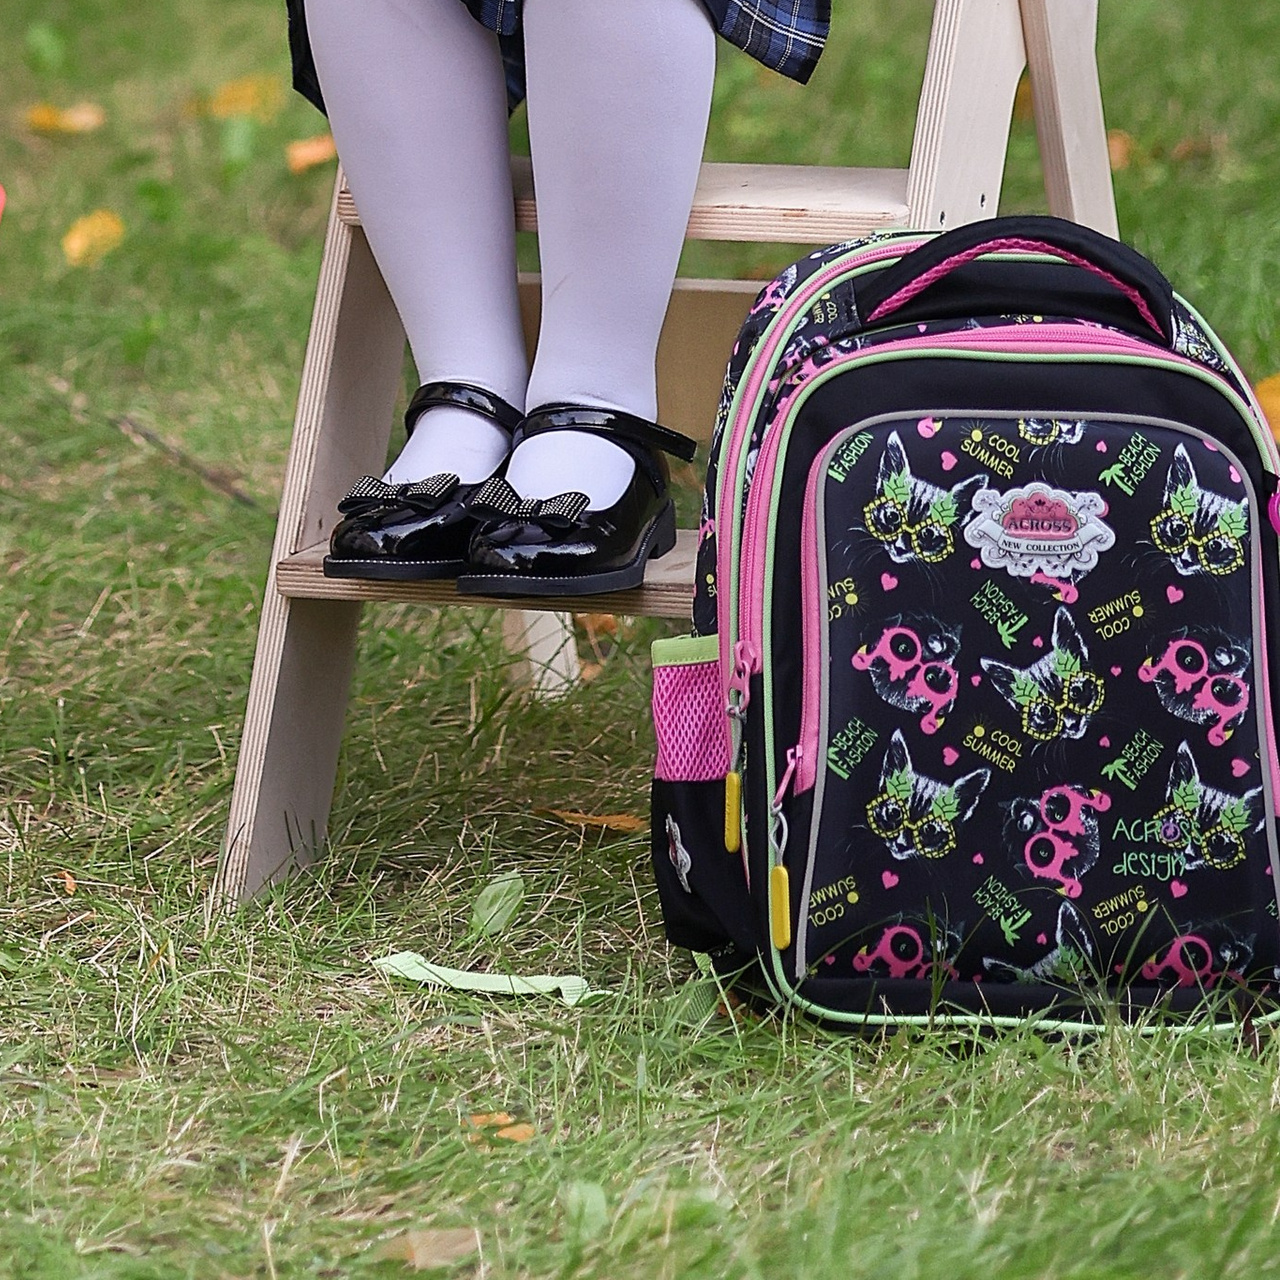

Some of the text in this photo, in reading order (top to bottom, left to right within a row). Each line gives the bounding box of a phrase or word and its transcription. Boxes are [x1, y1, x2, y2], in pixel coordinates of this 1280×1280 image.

[833, 431, 874, 476] FASHION
[960, 440, 1014, 480] SUMMER
[988, 434, 1020, 463] COOL
[1119, 432, 1148, 466] BEACH
[1125, 443, 1162, 489] FASHION
[1008, 518, 1071, 533] ACROSS
[1002, 539, 1080, 552] NEW COLLECTION
[970, 592, 997, 624] BEACH
[981, 579, 1023, 624] FASHION
[1087, 590, 1141, 623] SUMMER
[1096, 618, 1130, 640] COOL
[833, 716, 865, 751] BEACH
[838, 727, 879, 774] FASHION
[990, 730, 1023, 758] COOL
[1122, 728, 1151, 761] BEACH
[963, 735, 1017, 773] SUMMER
[1126, 738, 1165, 785] FASHION
[1112, 851, 1187, 881] design
[972, 883, 1004, 920] BEACH
[983, 874, 1027, 920] FASHION
[1092, 885, 1145, 919] SUMMER
[808, 902, 844, 927] COOL
[1100, 912, 1135, 937] COOL
